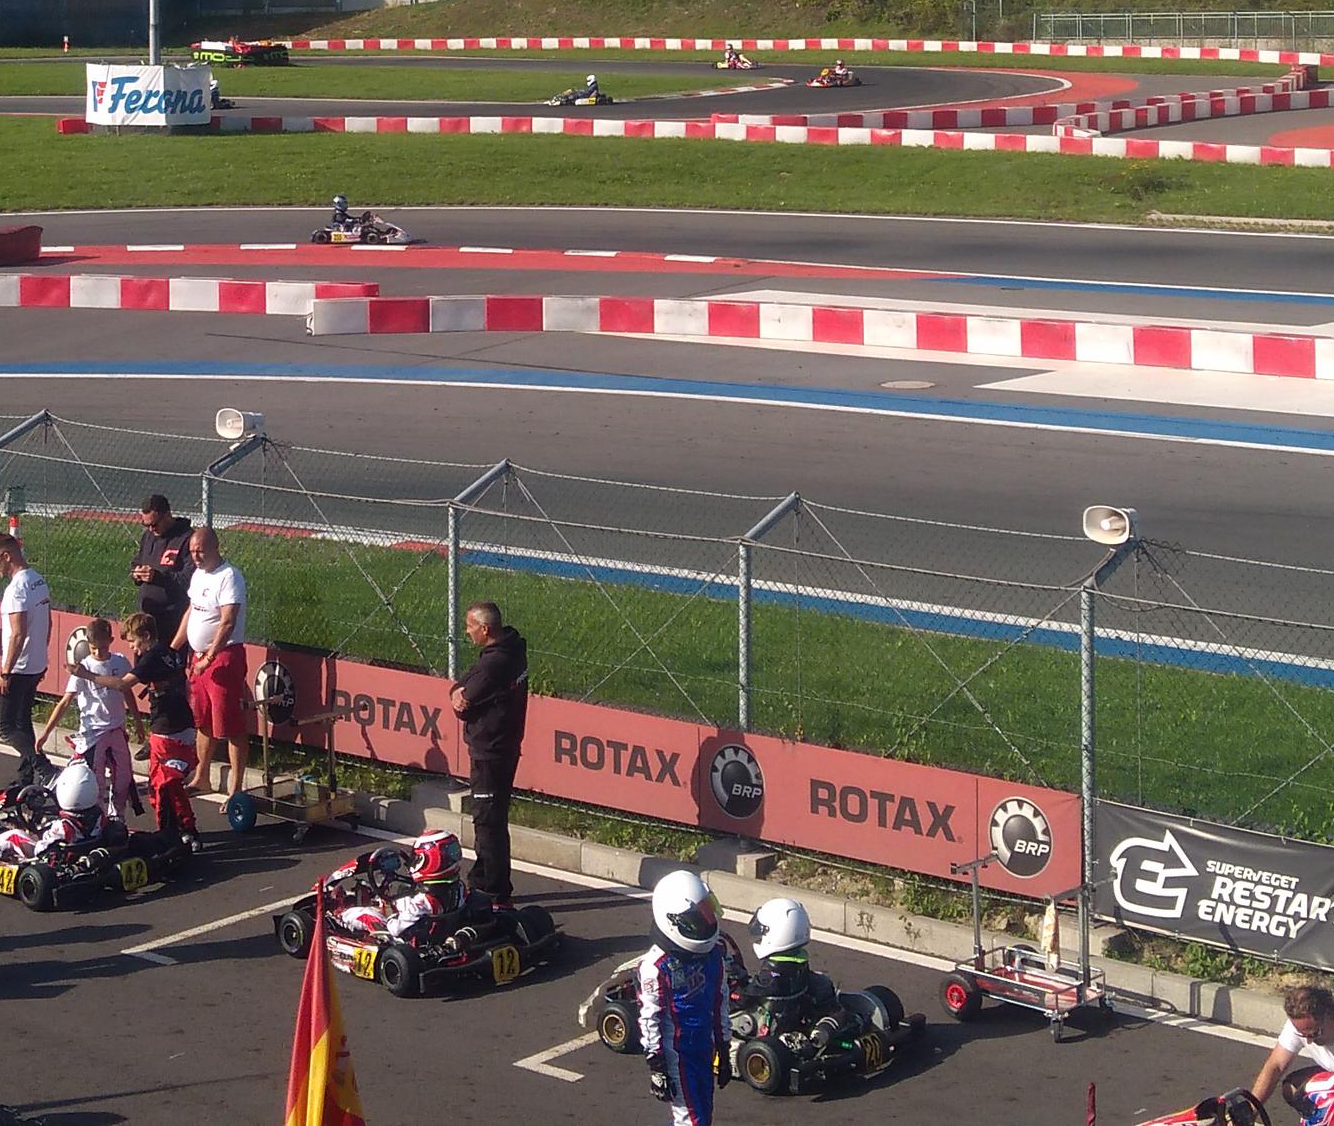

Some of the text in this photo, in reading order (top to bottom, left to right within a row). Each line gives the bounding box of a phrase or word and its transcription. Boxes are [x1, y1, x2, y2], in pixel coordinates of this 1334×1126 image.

[108, 76, 206, 114] Ferona
[335, 690, 443, 740] ROTAX
[554, 730, 681, 787] ROTAX
[732, 784, 762, 799] BRP
[810, 778, 957, 842] ROTAX
[1014, 839, 1050, 856] BRP
[125, 862, 143, 886] 42
[1206, 860, 1299, 889] SUPERVEGET
[1197, 899, 1307, 939] ENERGY
[357, 951, 371, 976] 12
[497, 949, 515, 977] 12
